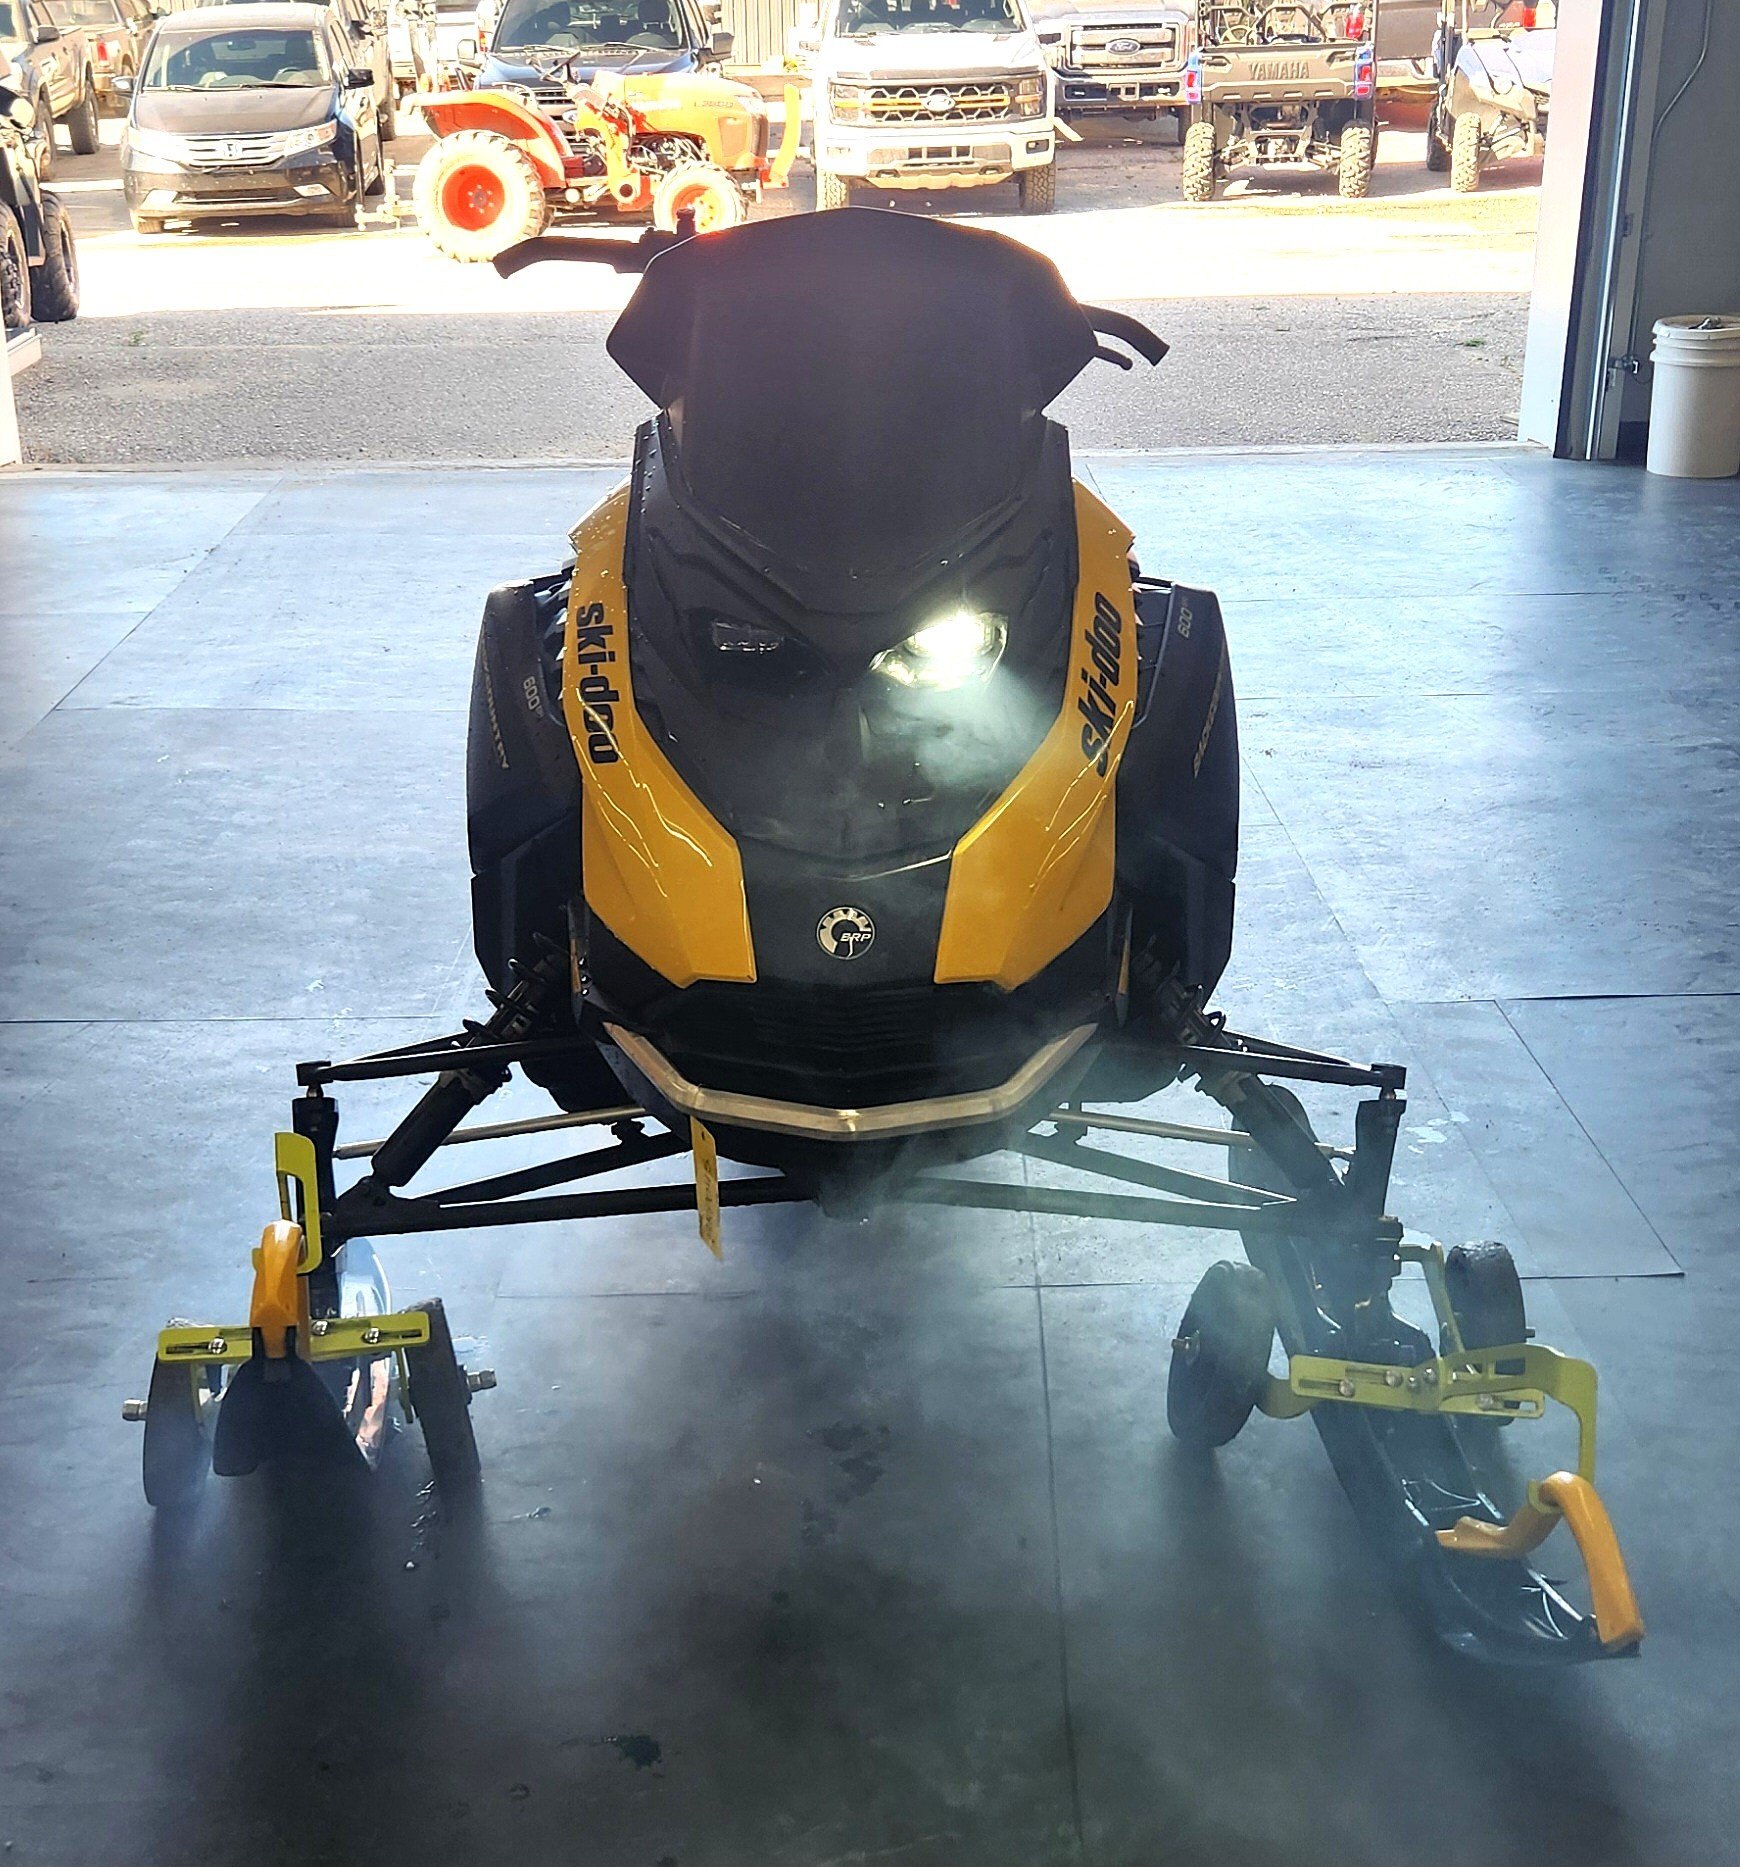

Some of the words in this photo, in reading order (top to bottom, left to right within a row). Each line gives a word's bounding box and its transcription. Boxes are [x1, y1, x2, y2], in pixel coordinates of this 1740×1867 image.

[1249, 61, 1310, 80] YAMAHA
[1177, 606, 1193, 638] 600
[523, 675, 541, 711] 600
[575, 602, 620, 764] ski-doo
[1077, 591, 1122, 778] ski-doo
[840, 932, 872, 942] BRP
